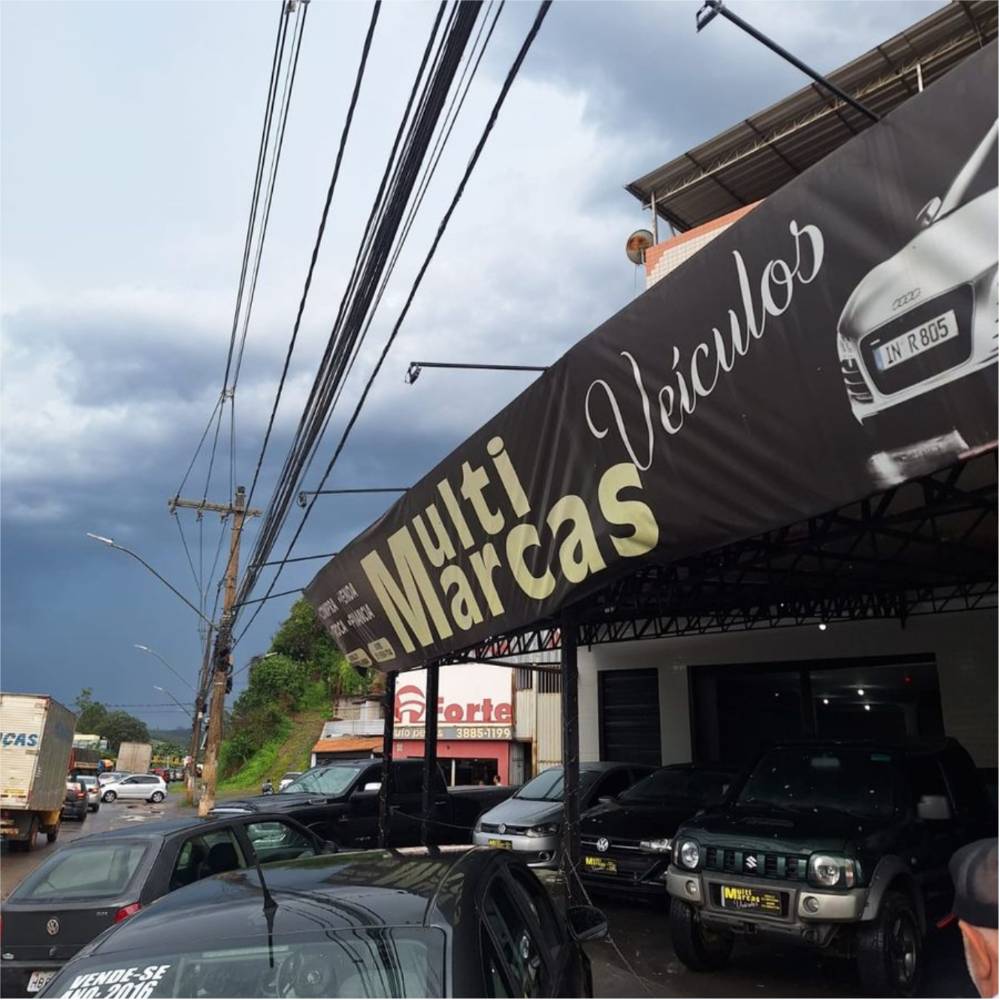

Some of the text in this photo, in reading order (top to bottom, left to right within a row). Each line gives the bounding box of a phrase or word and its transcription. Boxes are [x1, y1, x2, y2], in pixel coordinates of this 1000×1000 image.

[585, 219, 824, 471] Veículos
[885, 316, 949, 365] IN R 805
[360, 462, 659, 654] Marcas
[0, 732, 38, 748] ÇAS
[71, 965, 170, 988] VENDE-SE
[107, 980, 158, 999] 2016
